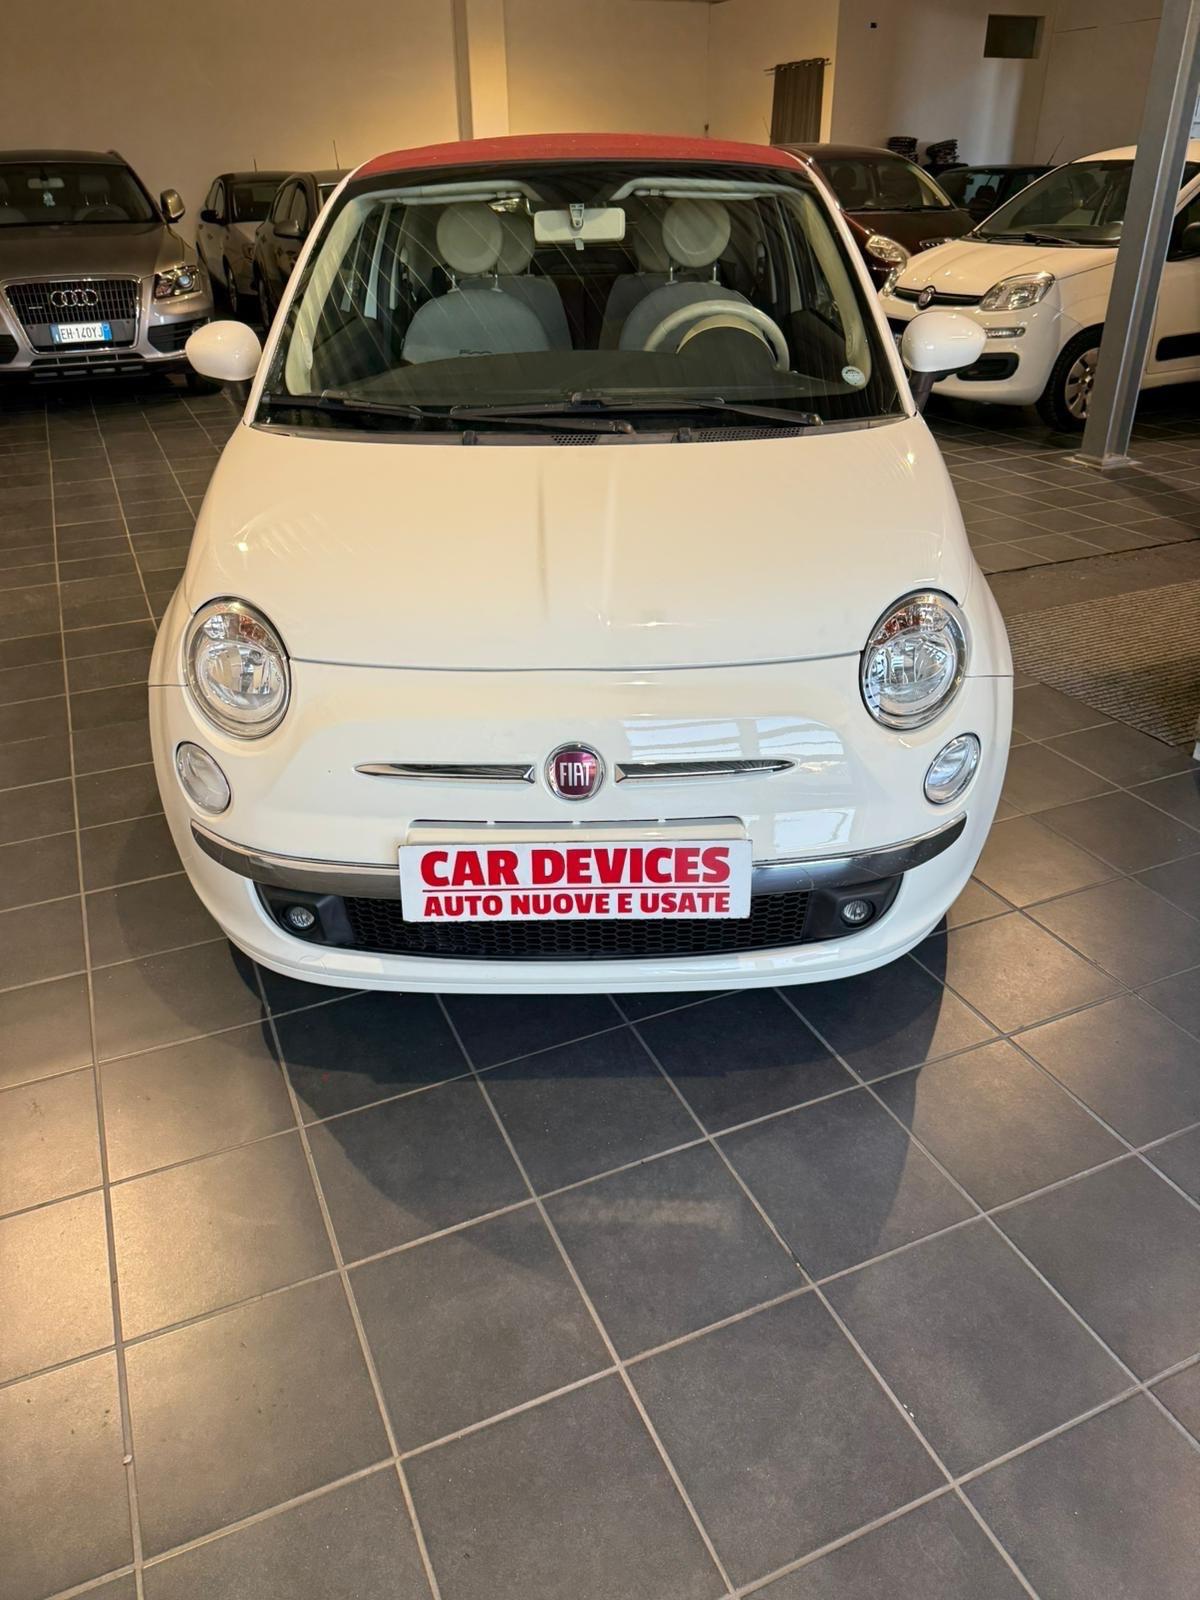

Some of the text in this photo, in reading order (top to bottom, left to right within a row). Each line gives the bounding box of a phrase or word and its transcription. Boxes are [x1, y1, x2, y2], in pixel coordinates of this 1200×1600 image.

[60, 328, 74, 340] EH
[559, 761, 593, 787] FIAT
[420, 847, 730, 887] CAR DEVICES
[423, 892, 730, 917] AUTO NUOVE E USATE
